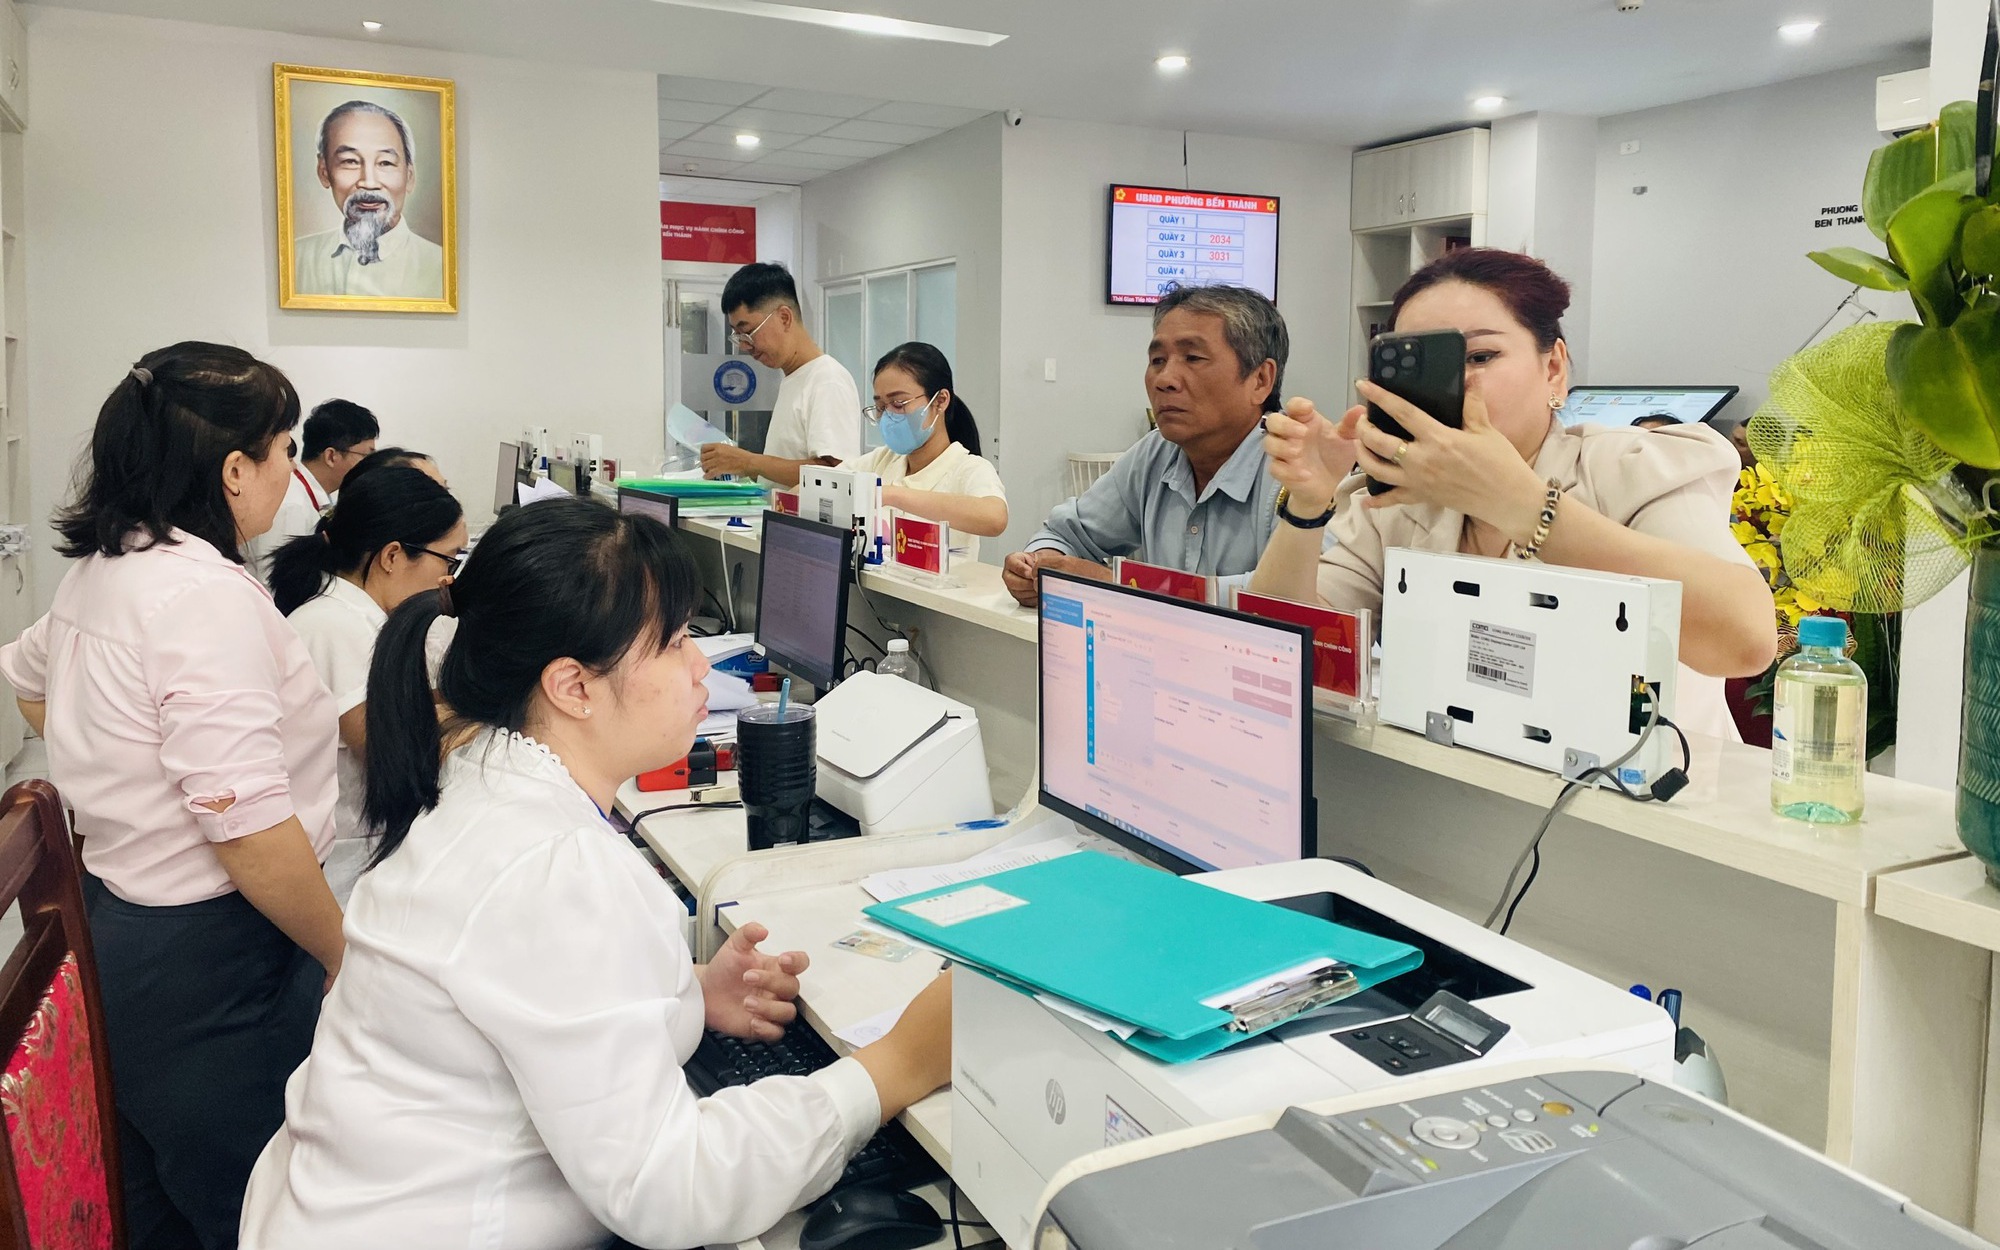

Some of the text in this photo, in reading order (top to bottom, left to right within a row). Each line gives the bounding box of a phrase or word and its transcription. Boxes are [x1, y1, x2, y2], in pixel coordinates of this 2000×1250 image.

[1136, 193, 1162, 203] UBND
[1206, 197, 1225, 207] BẾN
[1227, 199, 1258, 210] THÀNH
[1821, 205, 1858, 214] PHUONG
[1814, 219, 1832, 228] BEN
[1180, 234, 1186, 242] 2
[1209, 234, 1232, 244] 2034
[1180, 251, 1185, 259] 3
[1209, 251, 1231, 261] 3031
